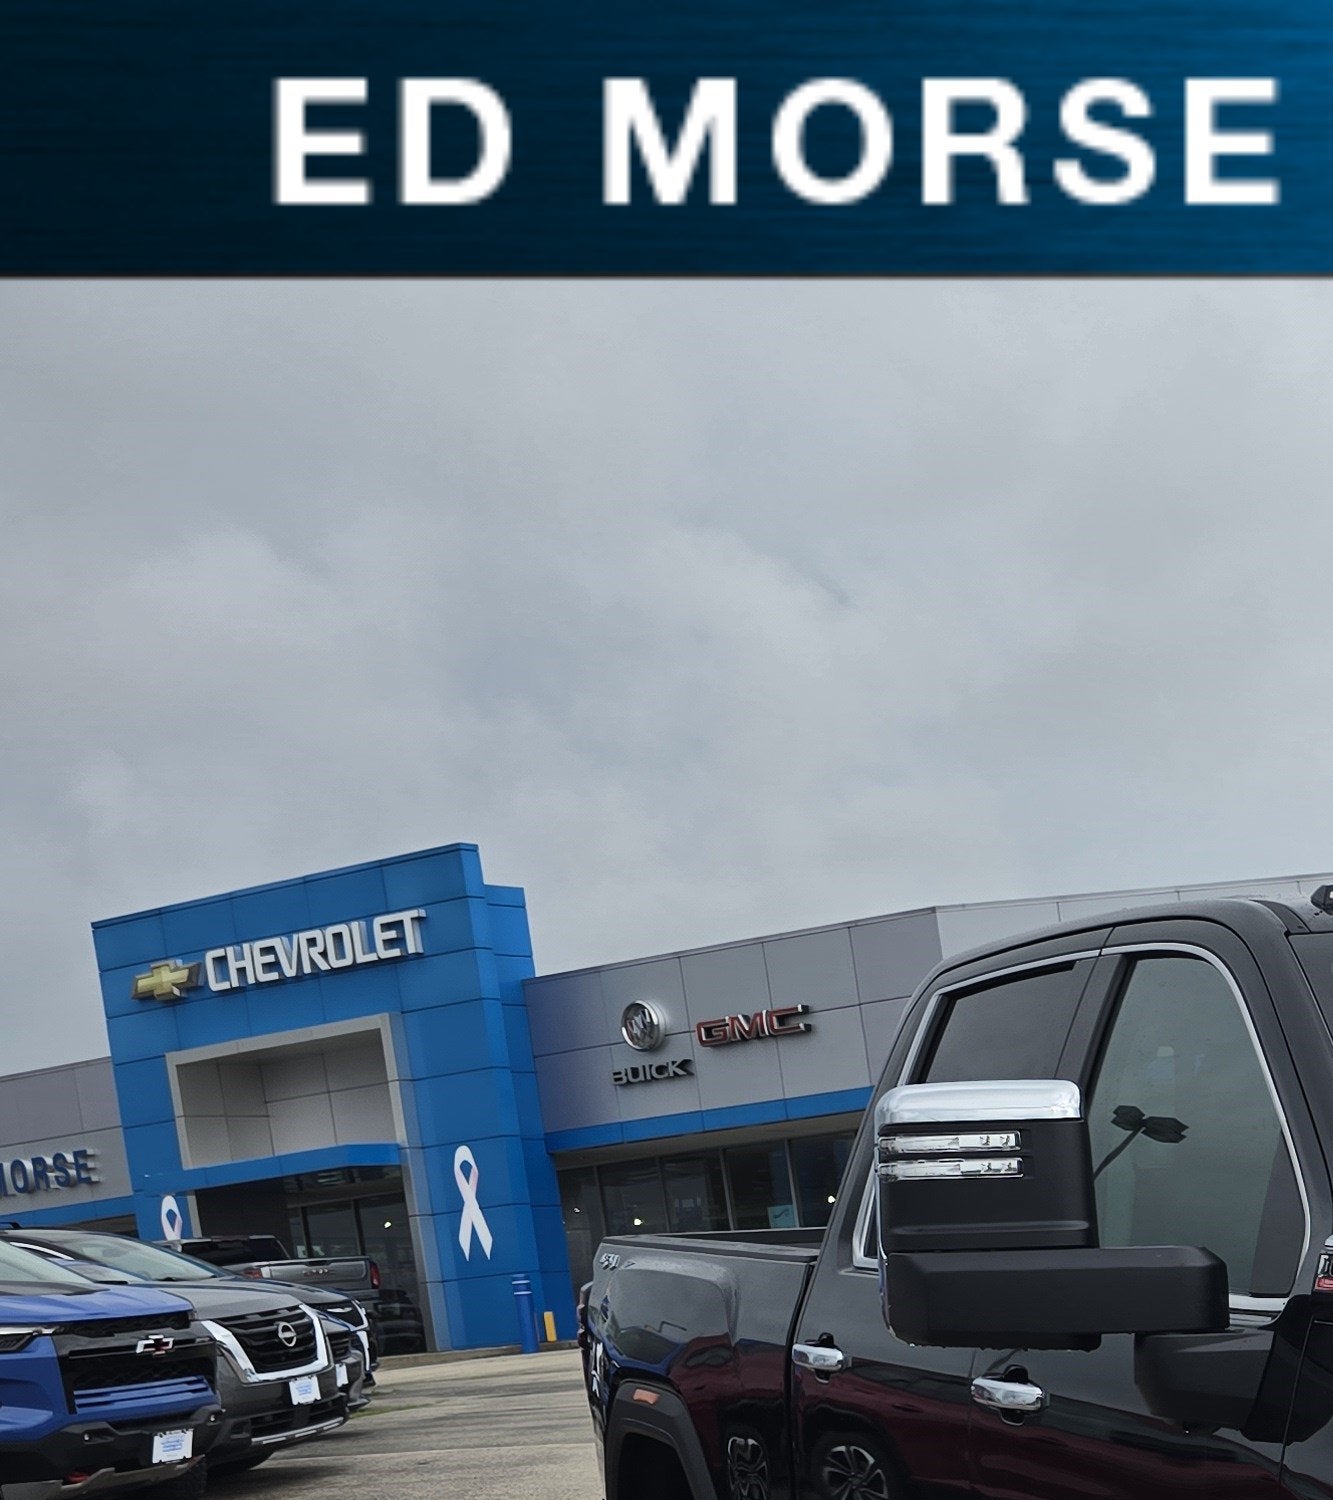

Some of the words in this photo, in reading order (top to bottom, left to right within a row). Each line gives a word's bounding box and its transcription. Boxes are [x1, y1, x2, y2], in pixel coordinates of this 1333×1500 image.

[204, 908, 427, 993] CHEVROLET
[695, 1003, 812, 1048] GMC
[610, 1057, 695, 1087] BUICK
